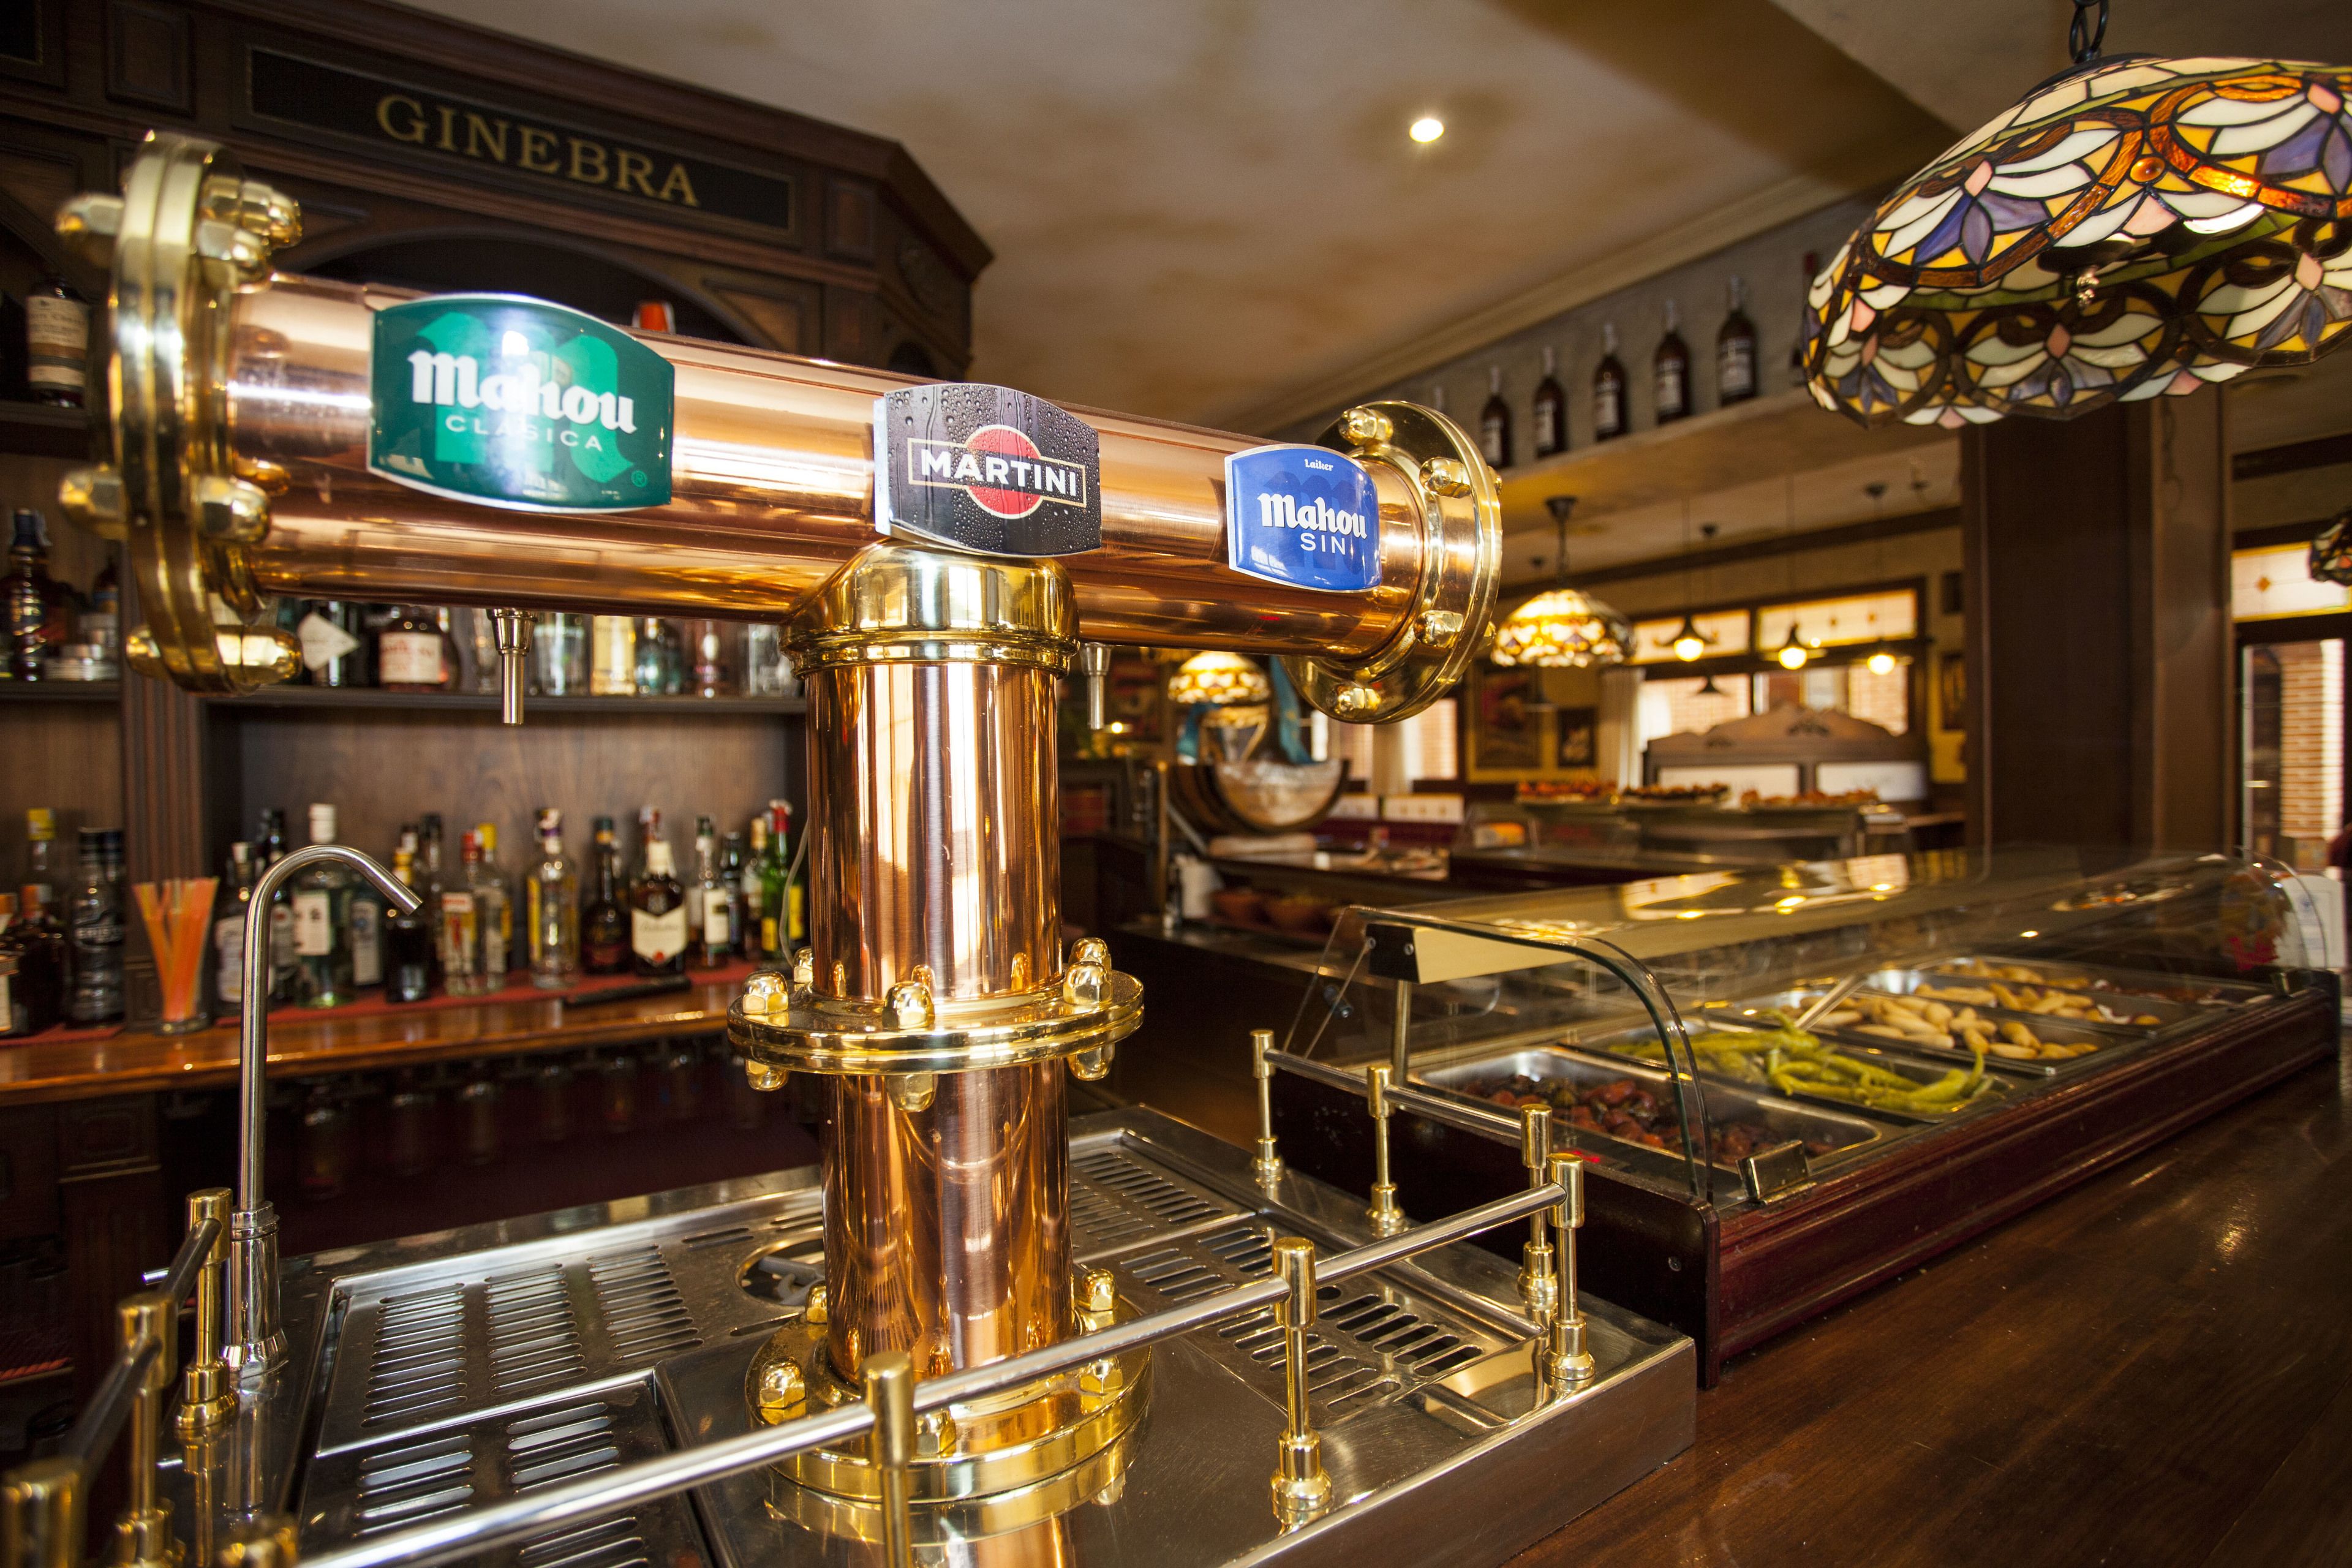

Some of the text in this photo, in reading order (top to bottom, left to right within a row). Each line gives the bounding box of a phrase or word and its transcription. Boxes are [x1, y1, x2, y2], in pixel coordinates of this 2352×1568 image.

[376, 94, 699, 208] GINEBRA
[921, 448, 1077, 497] MARTINI
[1304, 458, 1333, 472] Laiker
[1257, 492, 1368, 539] Mahou
[1300, 532, 1346, 555] SIN
